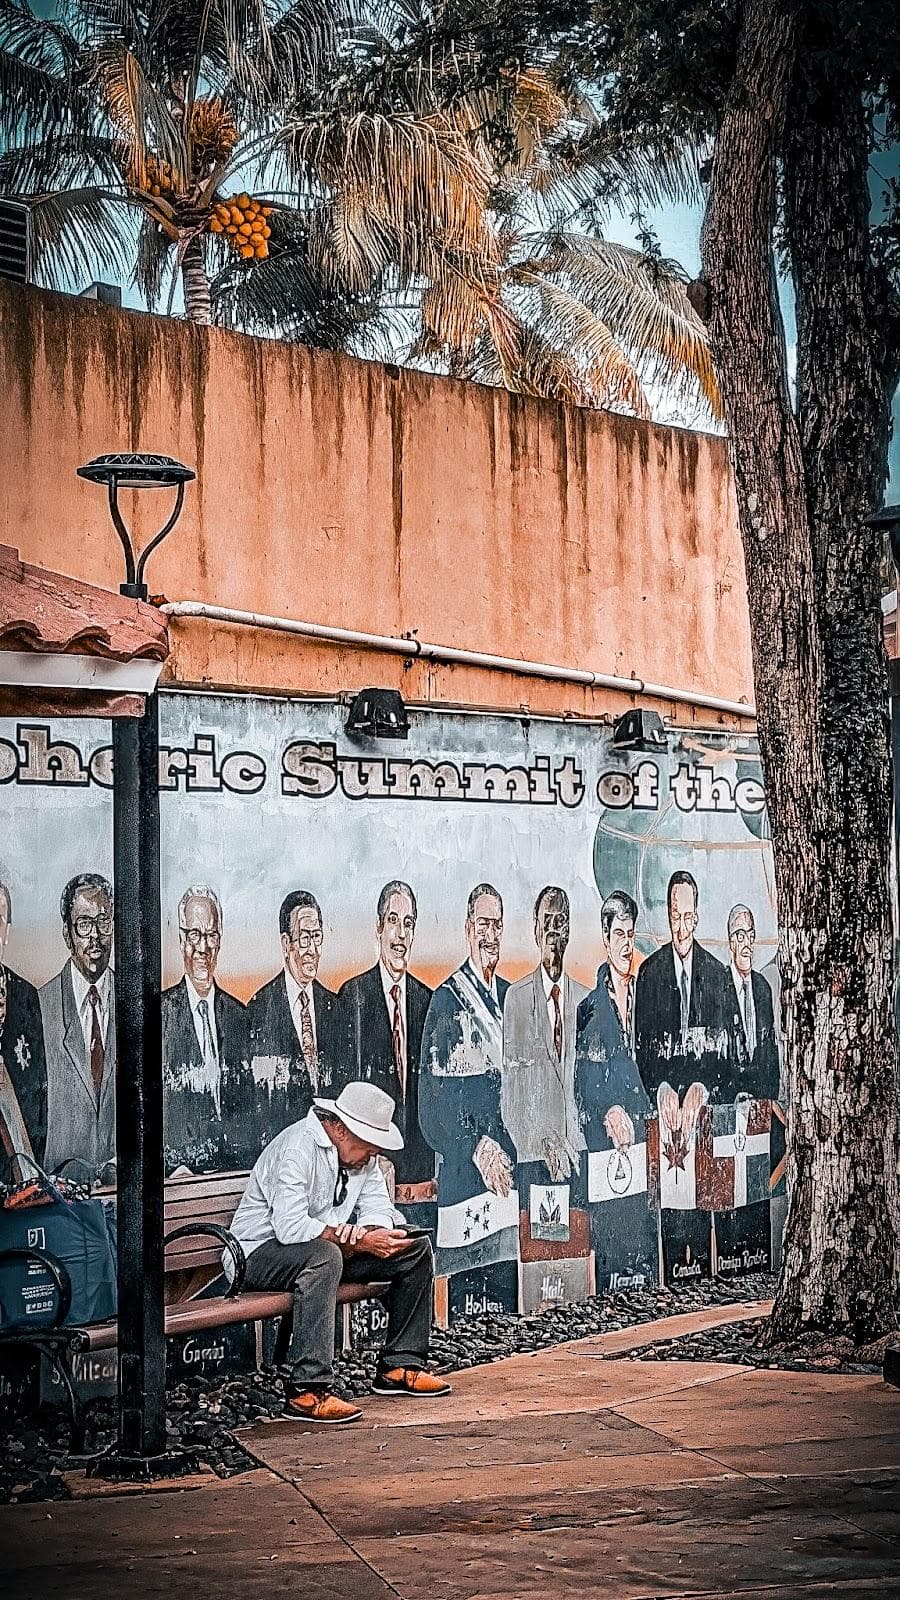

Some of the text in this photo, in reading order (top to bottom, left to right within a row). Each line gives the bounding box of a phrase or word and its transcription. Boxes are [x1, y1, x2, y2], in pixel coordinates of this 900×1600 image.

[282, 739, 585, 809] Summit
[597, 761, 659, 810] of
[669, 763, 766, 812] the
